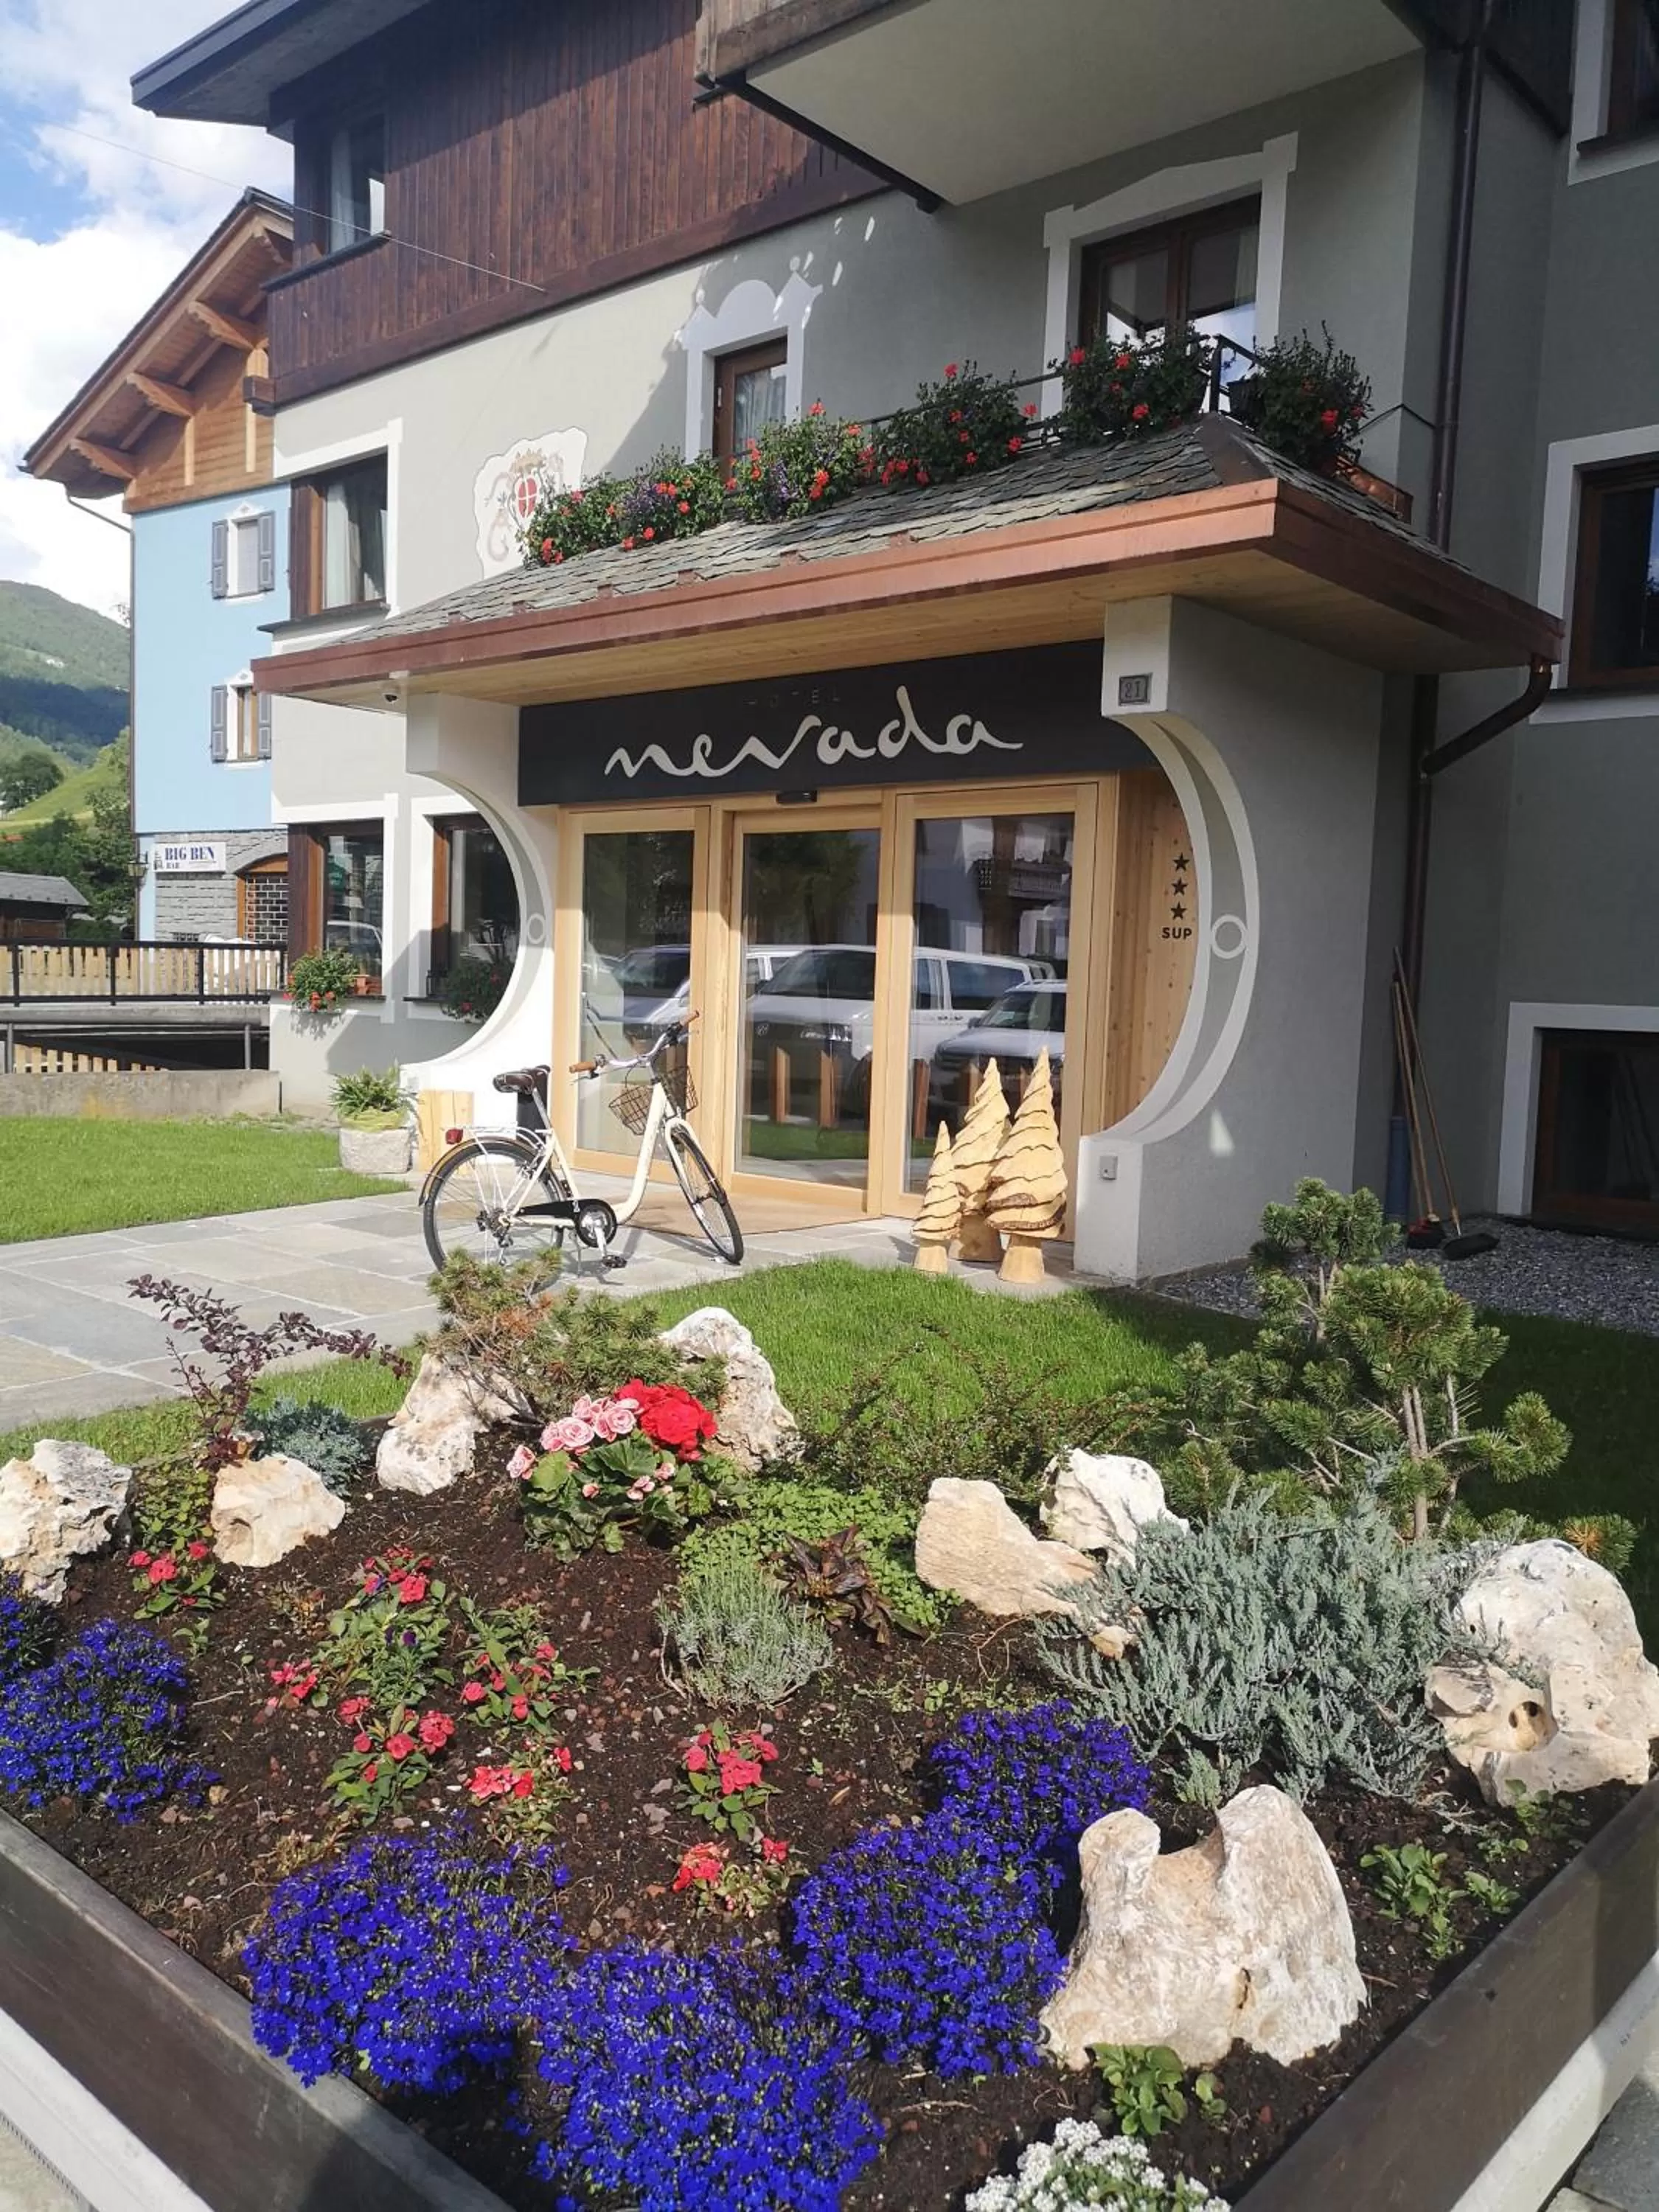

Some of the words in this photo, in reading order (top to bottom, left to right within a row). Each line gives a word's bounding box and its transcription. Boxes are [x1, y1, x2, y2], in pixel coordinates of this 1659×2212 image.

[604, 686, 1023, 778] nevada
[164, 847, 187, 860] BIG
[190, 846, 215, 860] BEN
[1162, 927, 1192, 939] SUP
